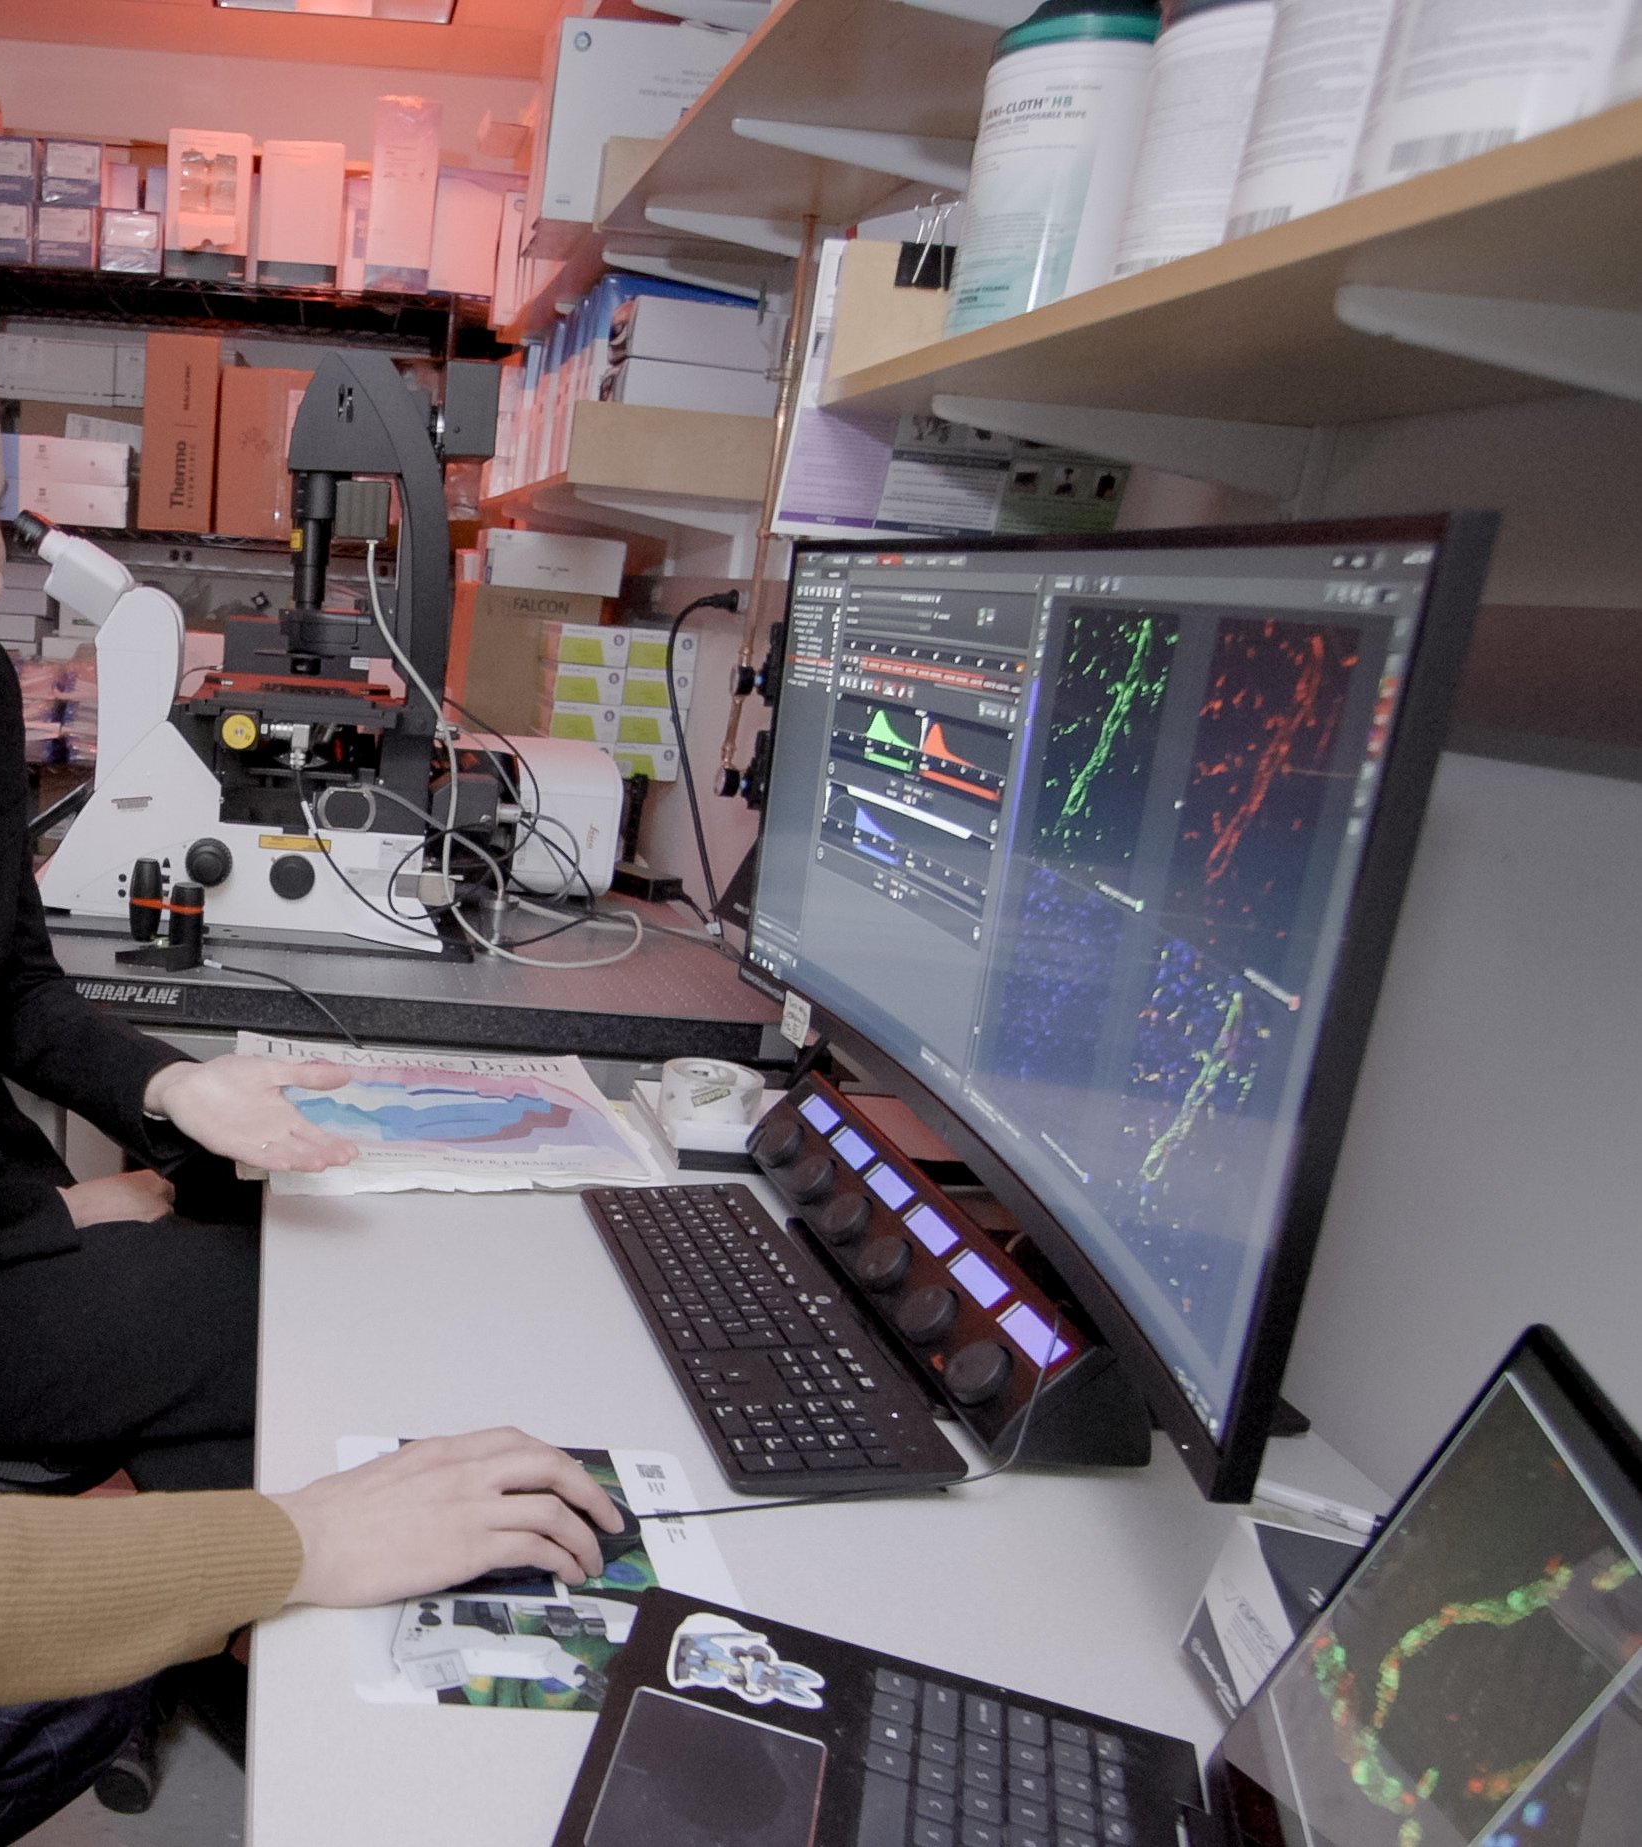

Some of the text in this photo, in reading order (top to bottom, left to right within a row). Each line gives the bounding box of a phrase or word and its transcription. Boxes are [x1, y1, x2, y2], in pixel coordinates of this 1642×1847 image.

[1051, 96, 1073, 108] HB
[169, 440, 187, 509] Thermo
[512, 596, 570, 615] FALCON
[75, 982, 181, 1005] VIBRAPLANE
[266, 1040, 326, 1059] The
[342, 1050, 454, 1069] Mouse
[470, 1059, 561, 1074] Brain
